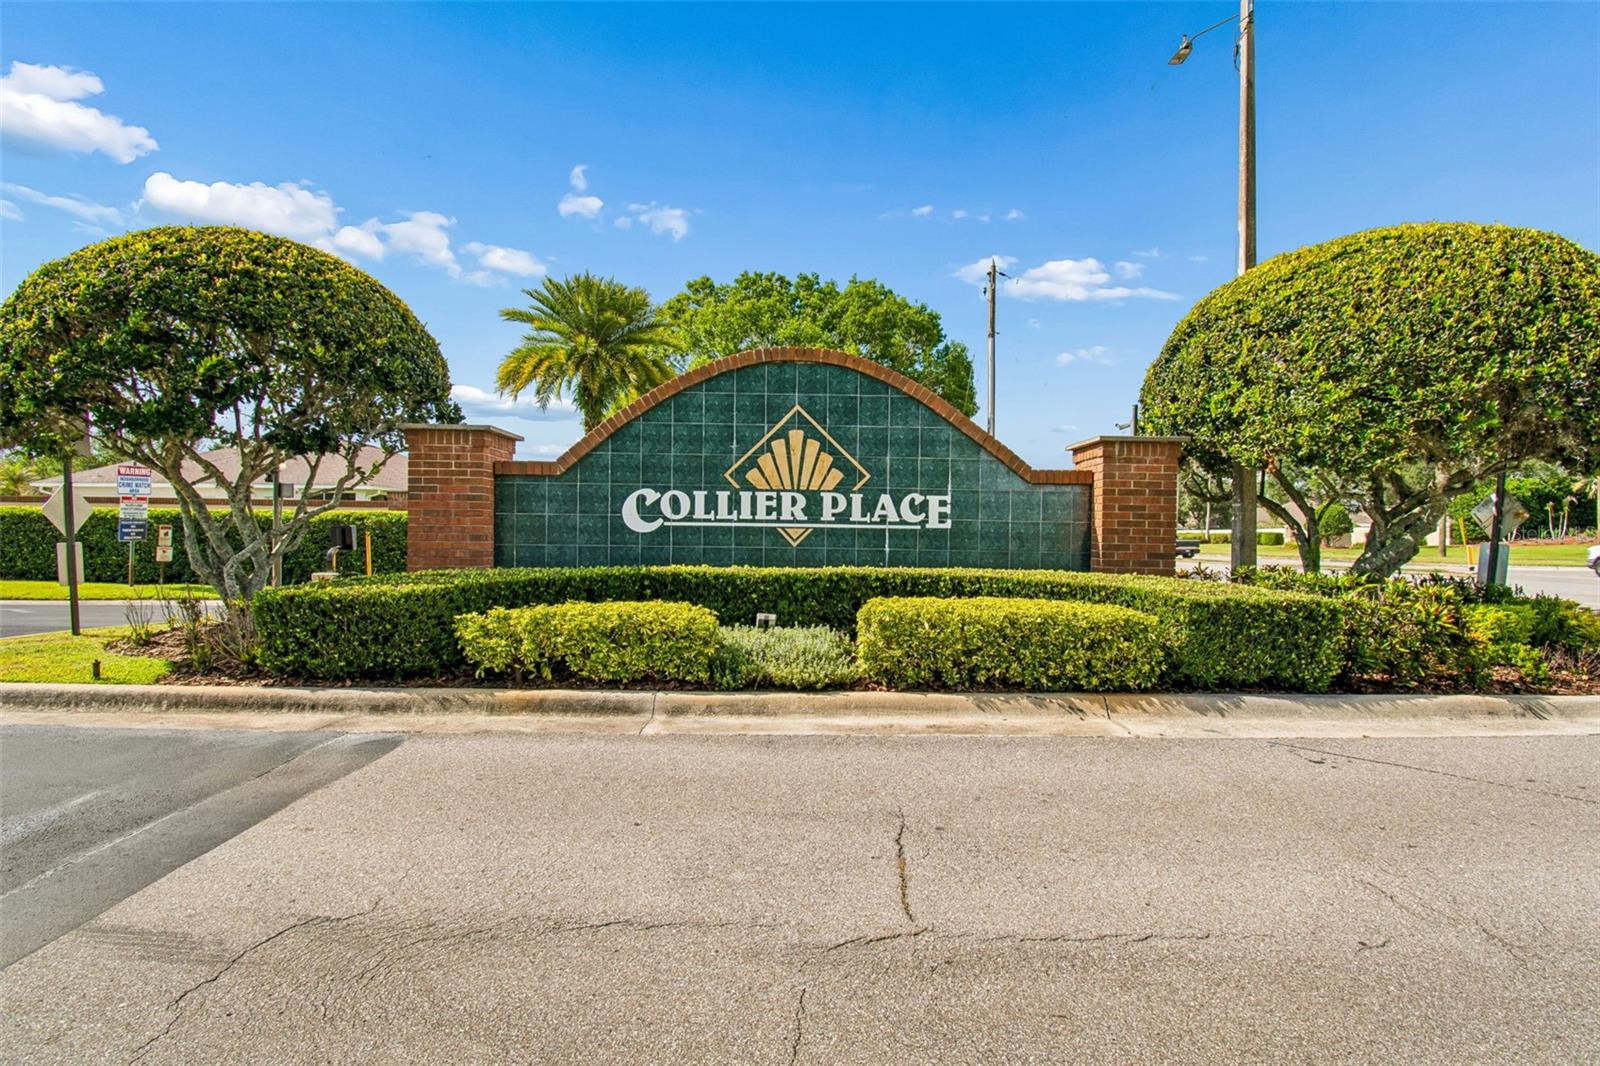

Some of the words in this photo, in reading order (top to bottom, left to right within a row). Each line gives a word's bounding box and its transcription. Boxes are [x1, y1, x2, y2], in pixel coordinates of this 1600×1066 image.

[119, 468, 151, 476] WARNING
[622, 488, 808, 533] COLLIER
[820, 492, 952, 529] PLACE
